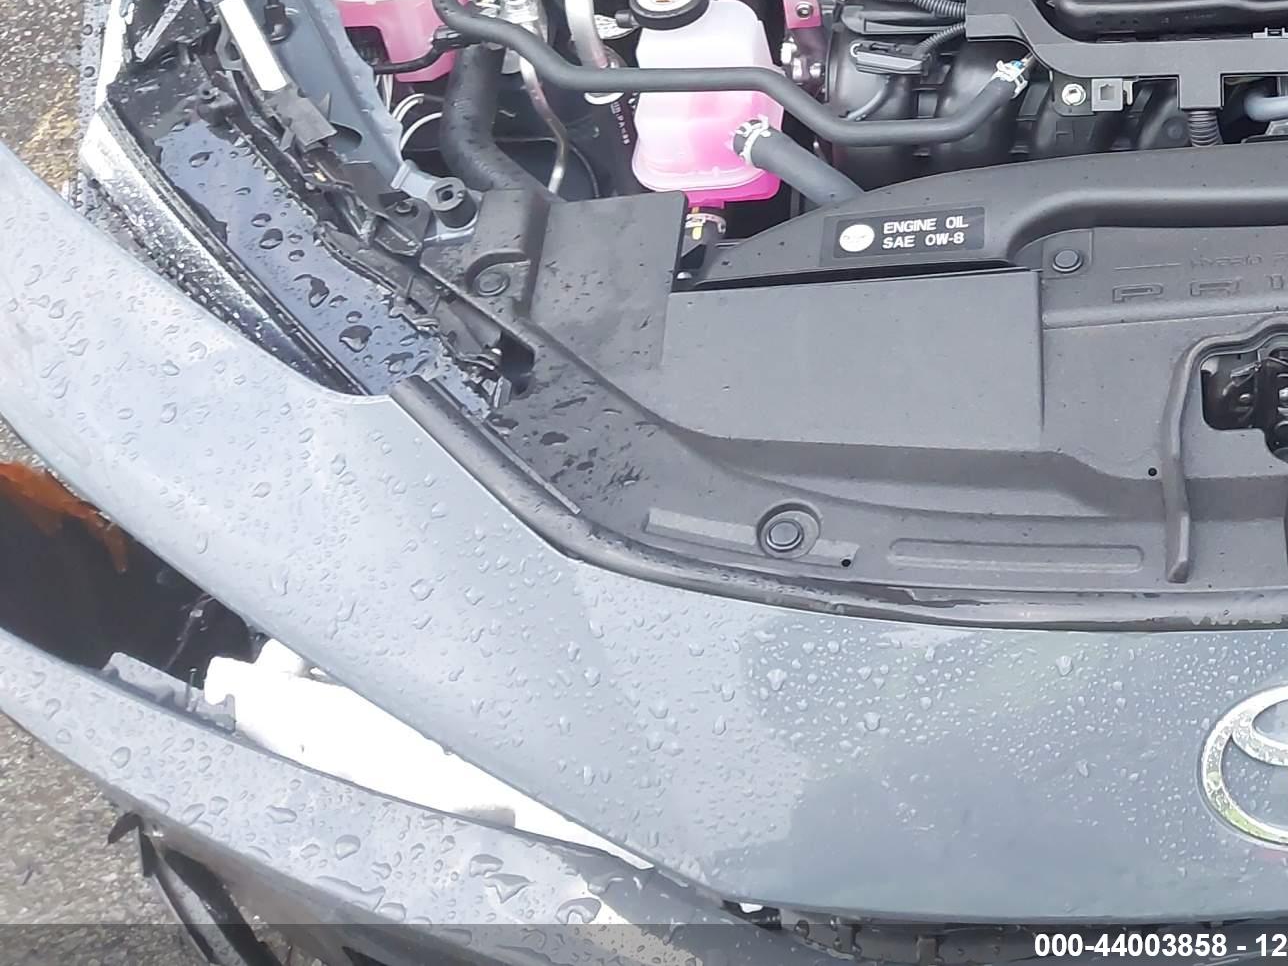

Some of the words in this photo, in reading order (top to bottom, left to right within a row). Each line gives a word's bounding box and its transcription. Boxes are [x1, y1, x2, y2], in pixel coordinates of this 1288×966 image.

[883, 218, 937, 234] ENGINE
[945, 216, 969, 229] OIL
[882, 235, 915, 249] SAE
[925, 232, 964, 246] 0W-8
